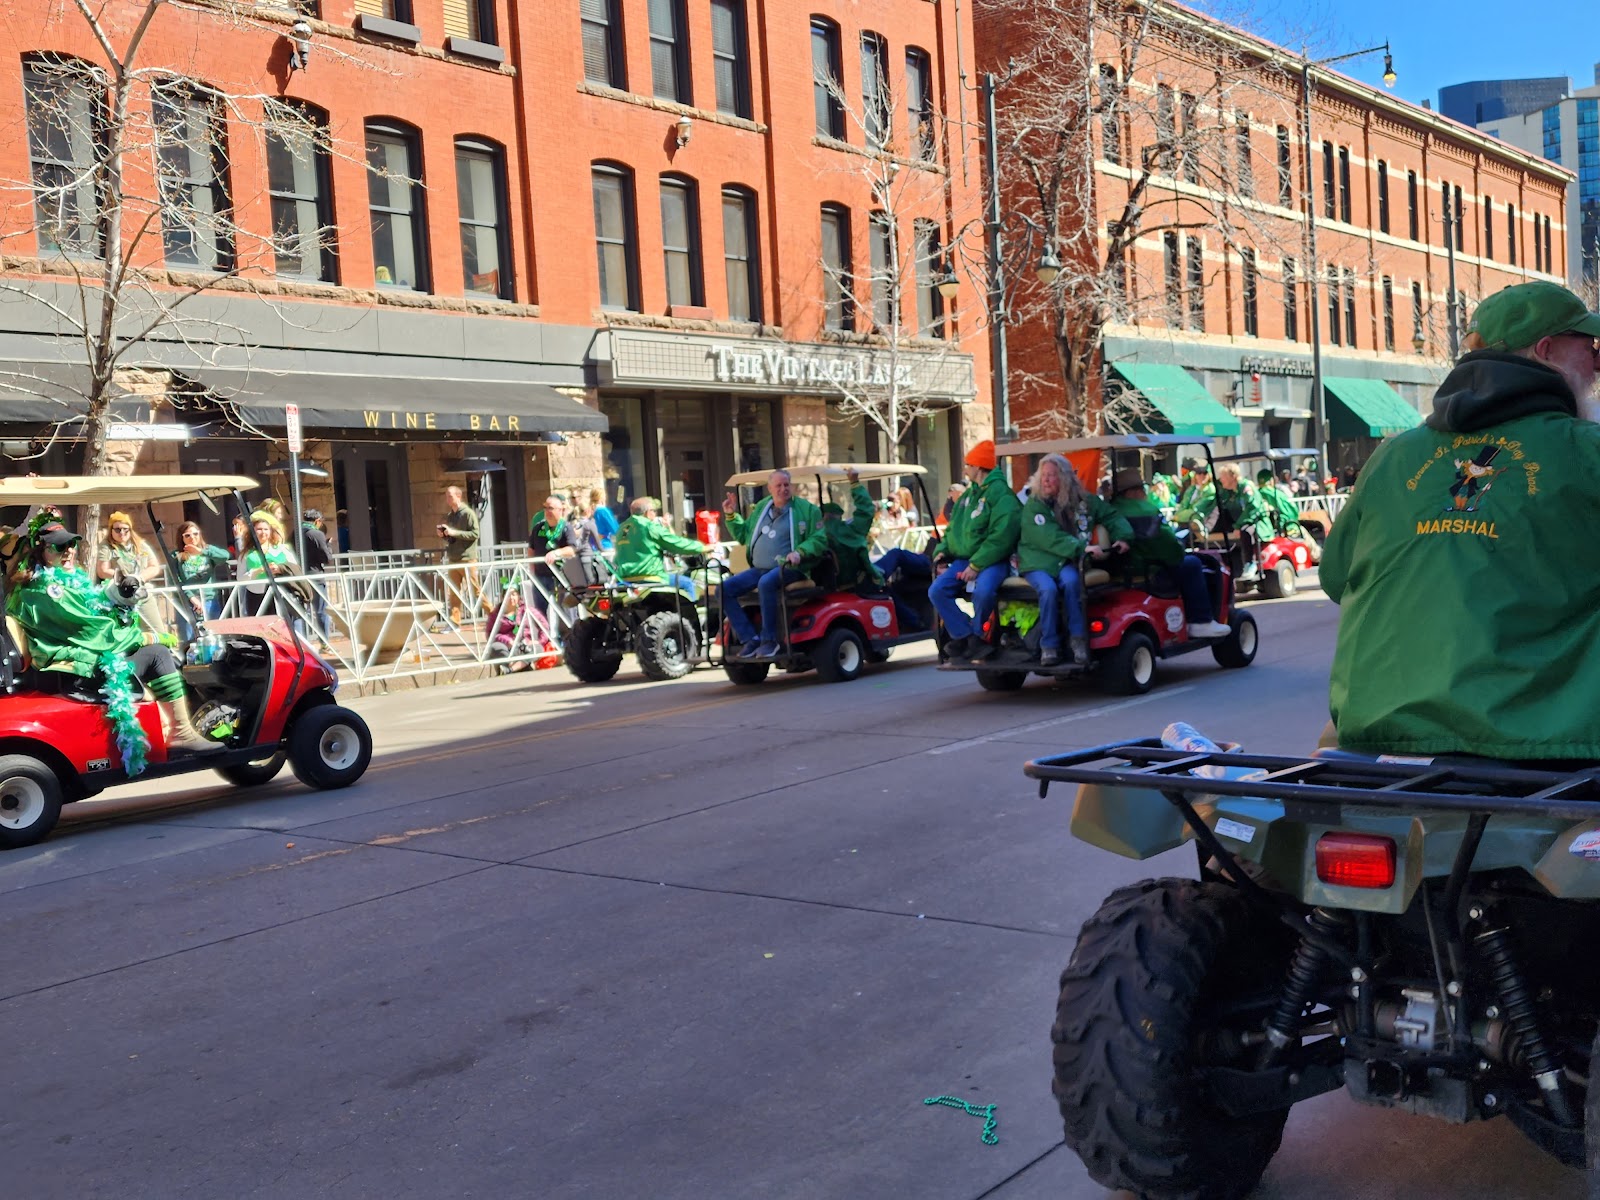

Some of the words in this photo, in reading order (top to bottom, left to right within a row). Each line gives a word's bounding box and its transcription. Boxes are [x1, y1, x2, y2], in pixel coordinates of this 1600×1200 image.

[711, 344, 764, 378] THE
[363, 410, 437, 429] WINE
[469, 414, 520, 431] BAR
[1405, 459, 1435, 491] Denver
[1452, 433, 1495, 449] Patrick's
[1522, 461, 1541, 496] Parade
[1416, 518, 1500, 539] MARSHAL
